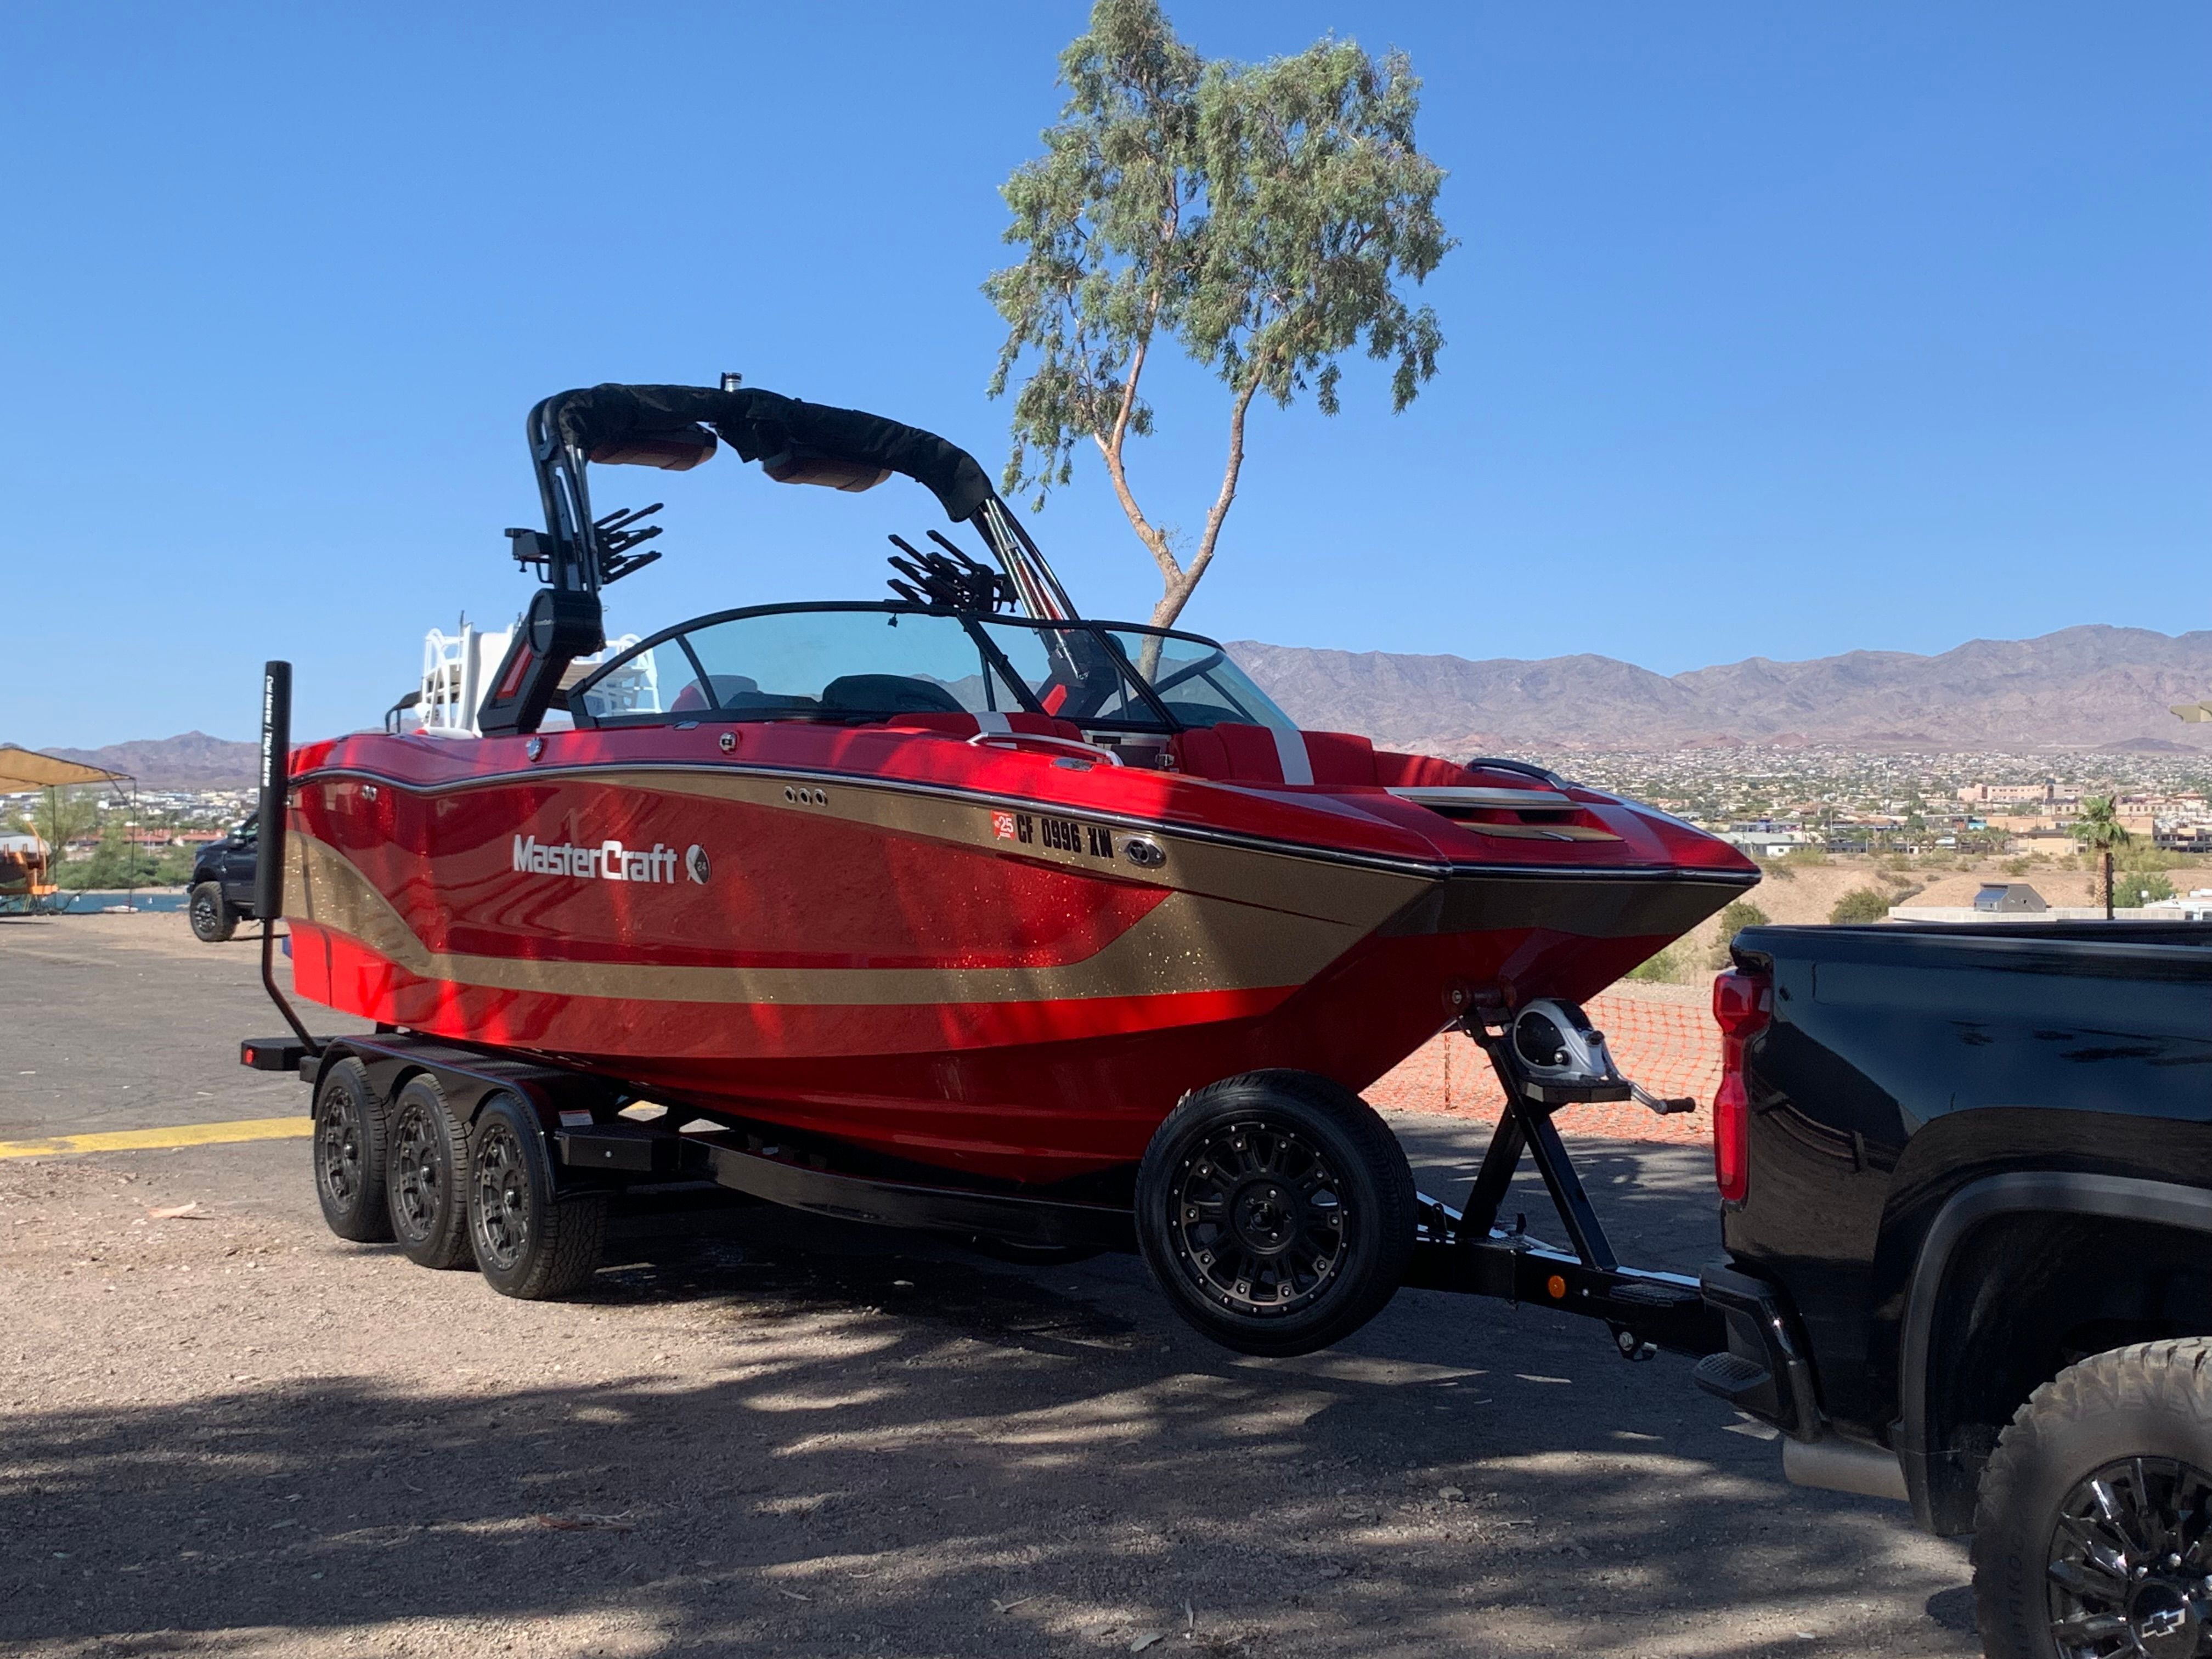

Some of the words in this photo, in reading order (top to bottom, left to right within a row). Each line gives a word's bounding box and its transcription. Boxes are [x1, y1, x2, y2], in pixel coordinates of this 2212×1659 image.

[998, 816, 1014, 833] 25
[1017, 814, 1033, 844] CF
[1042, 818, 1081, 853] 0996
[514, 834, 678, 884] MasterCraft
[697, 861, 707, 871] 24
